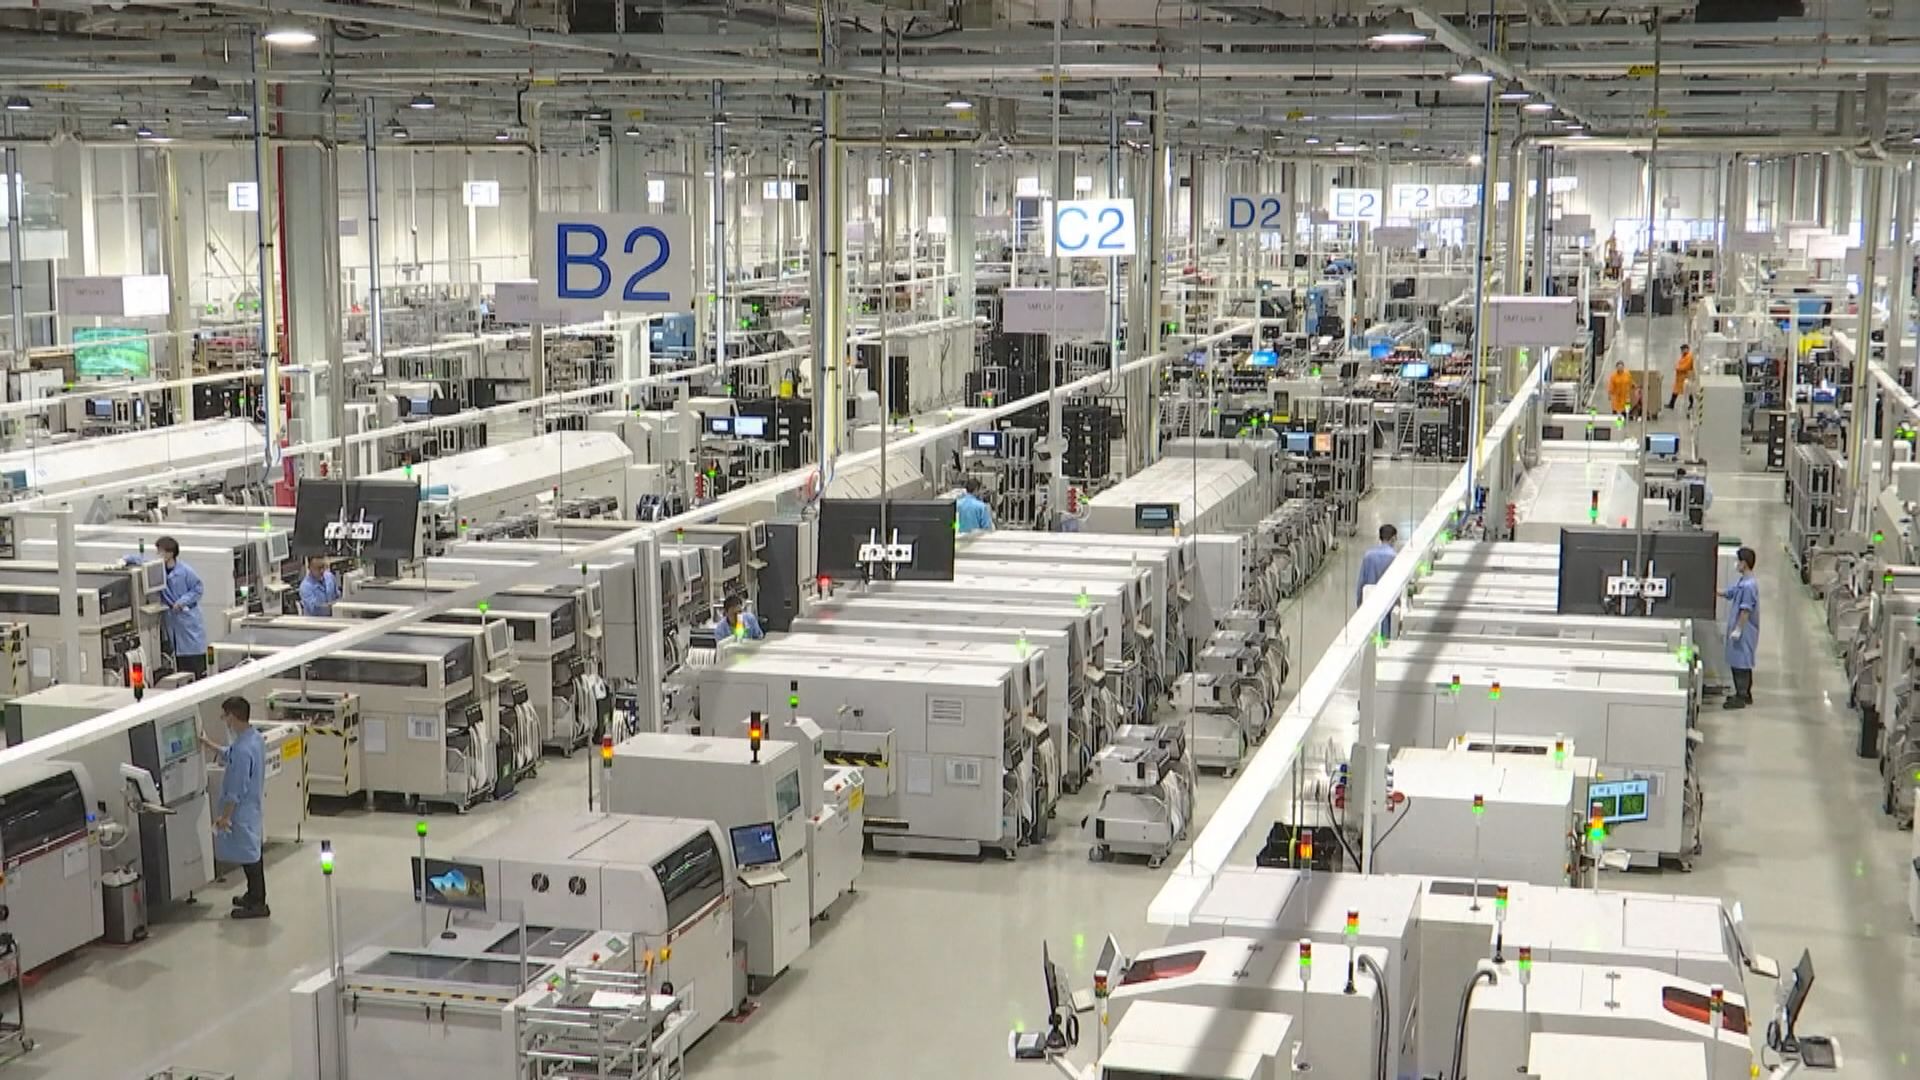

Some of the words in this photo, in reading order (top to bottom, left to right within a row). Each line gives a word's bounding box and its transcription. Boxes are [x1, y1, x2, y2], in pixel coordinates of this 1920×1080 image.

[1336, 192, 1376, 217] E2
[1398, 187, 1430, 207] F2
[1440, 187, 1470, 205] G2
[1230, 198, 1281, 229] D2
[1056, 207, 1126, 251] C2
[557, 223, 671, 301] B2
